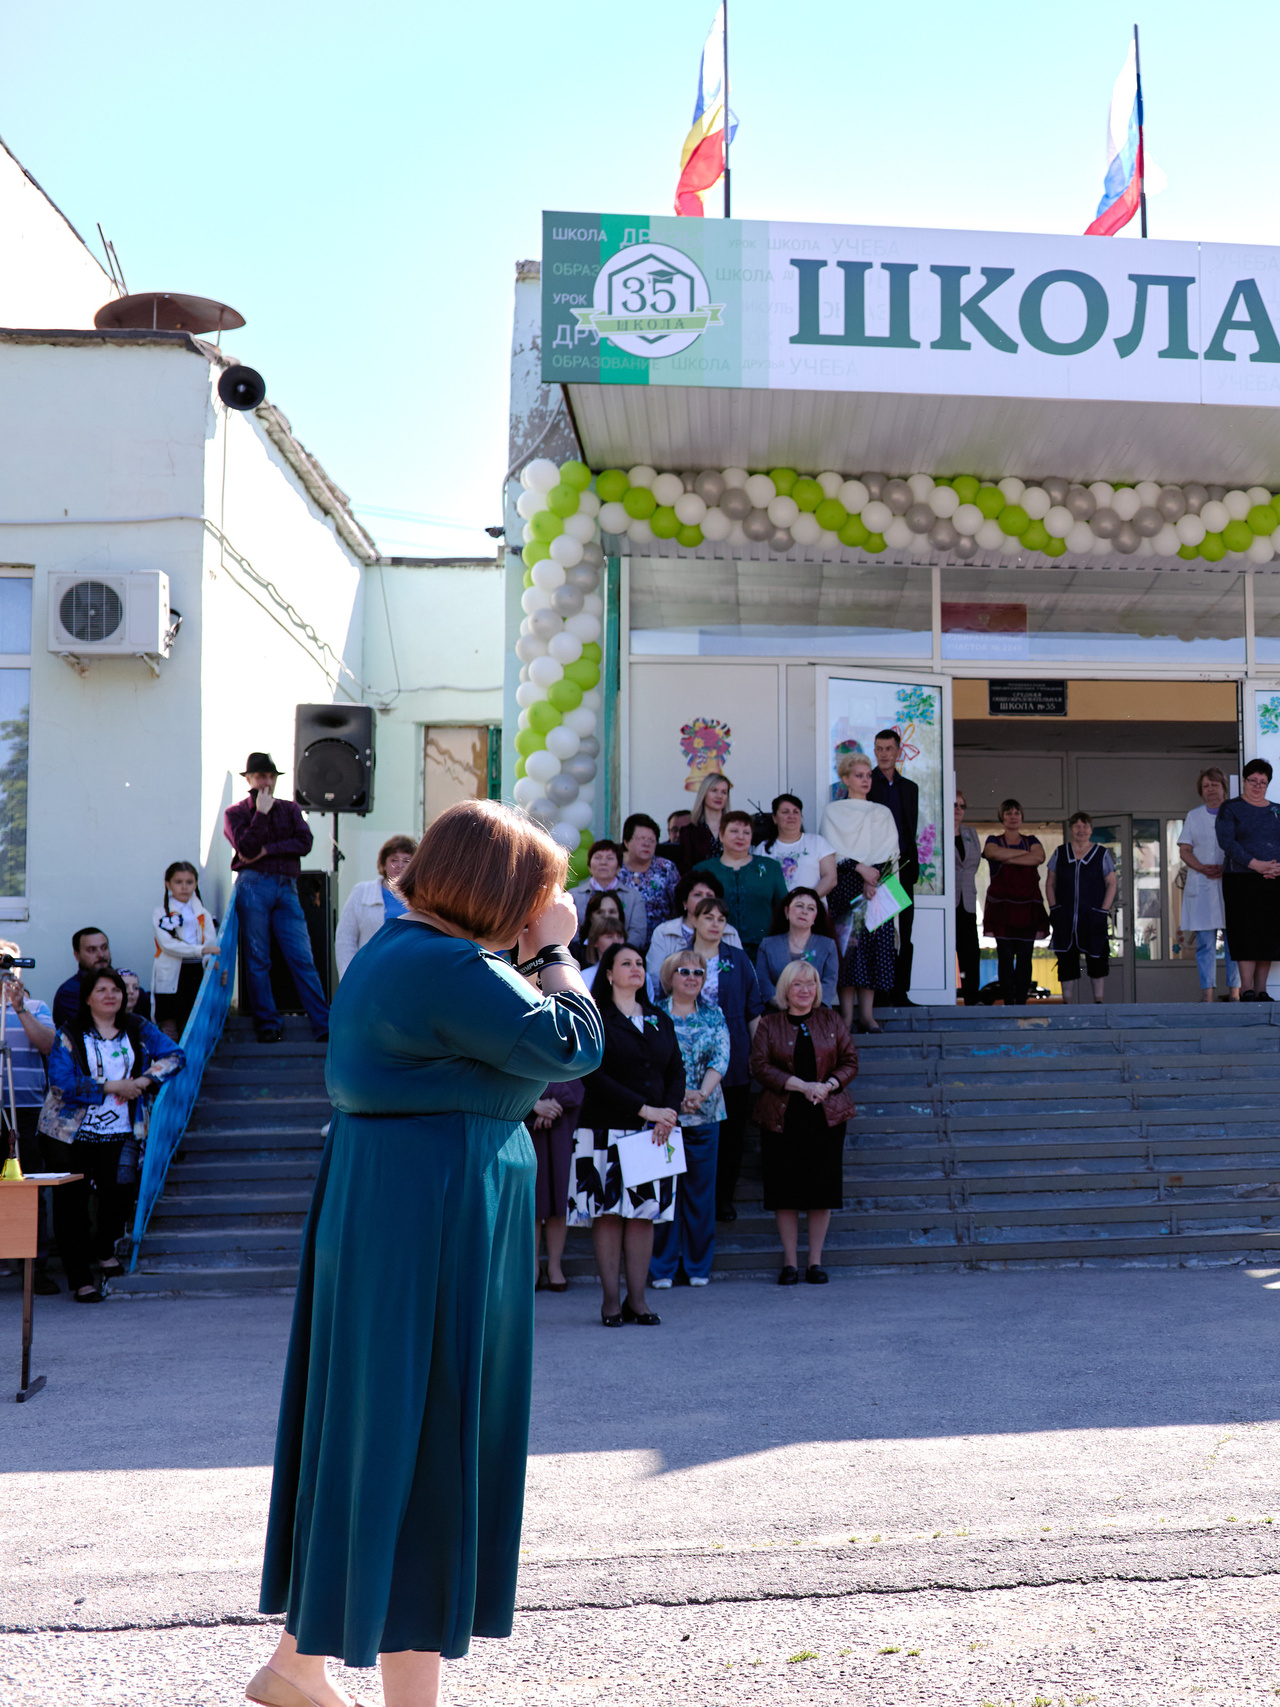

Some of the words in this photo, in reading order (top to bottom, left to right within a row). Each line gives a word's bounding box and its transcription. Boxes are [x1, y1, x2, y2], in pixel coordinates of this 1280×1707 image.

[552, 227, 608, 242] ШКОЛА
[620, 228, 710, 249] ДРУЗЬЯ
[767, 238, 821, 251] ШКОЛА
[831, 238, 901, 257] УЧЕБА
[715, 268, 775, 283] ШКОЛА
[552, 293, 587, 306] УРОК
[621, 276, 677, 314] 35
[616, 317, 686, 332] ШКОЛА
[552, 354, 660, 371] ОБРАЗОВАНИЕ
[671, 357, 731, 372] ШКОЛА
[790, 358, 859, 377] УЧЕБА
[999, 702, 1034, 711] ШКОЛА
